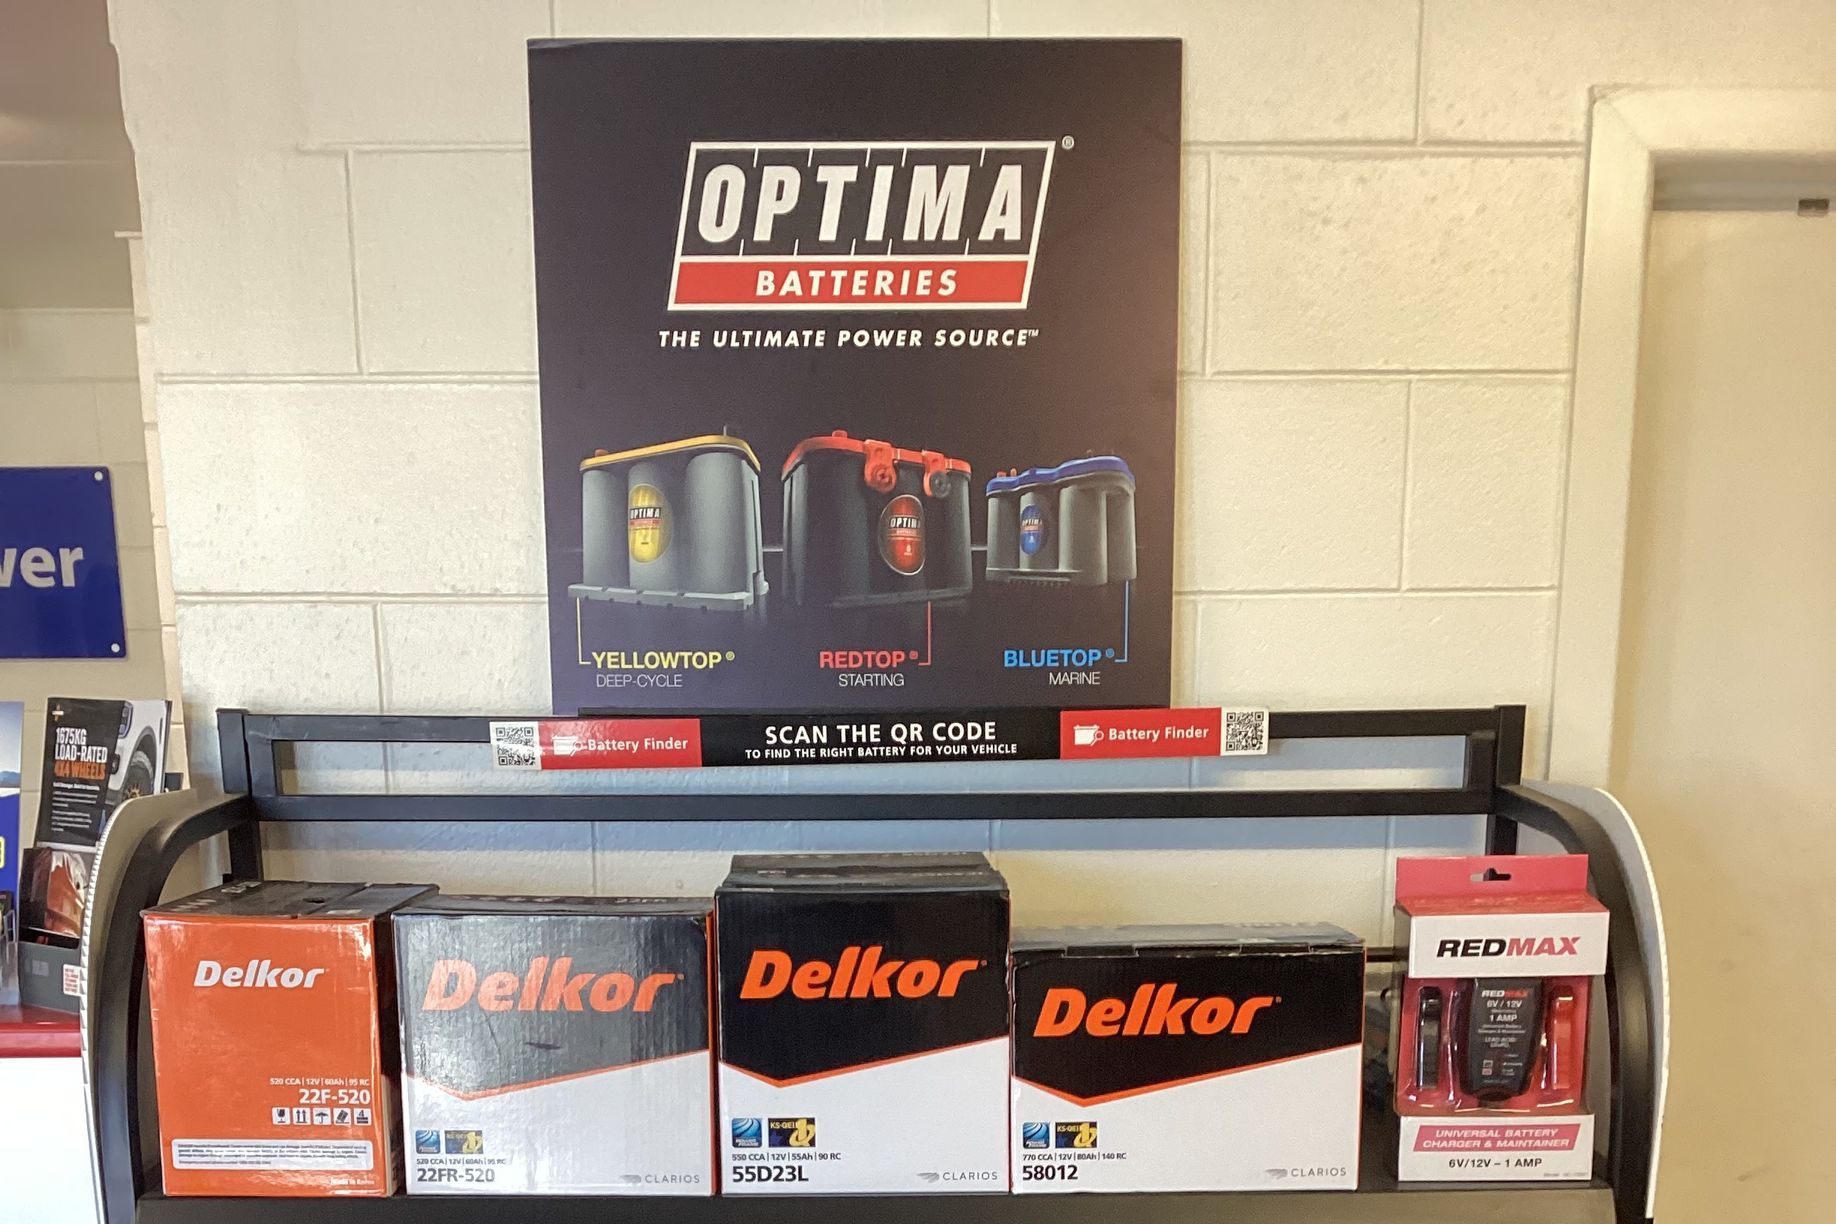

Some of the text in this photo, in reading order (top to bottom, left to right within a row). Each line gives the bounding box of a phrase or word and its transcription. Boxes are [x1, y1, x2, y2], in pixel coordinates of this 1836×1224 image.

[697, 163, 1023, 243] OPTIMA
[755, 269, 958, 297] BATTERIES
[659, 330, 701, 347] THE
[713, 330, 826, 347] ULTIMATE
[838, 330, 922, 347] POWER
[592, 651, 722, 669] YELLOWTOP
[820, 651, 905, 668] REDTOP
[1004, 649, 1102, 667] BLUETOP
[596, 674, 683, 687] DEEP-CYCLE
[838, 673, 904, 687] STARTING
[1048, 671, 1101, 685] MARINE
[56, 727, 87, 745] 1675KG
[765, 722, 996, 745] SCAN THE QR CODE
[1108, 726, 1209, 742] Battery Finder
[55, 744, 108, 763] LOAD-RATED
[587, 738, 689, 753] Battery Finder
[745, 744, 1017, 759] TO FIND THE RIGHT BATTERY FOR YOUR VEHICLE
[1437, 937, 1581, 957] REDMAX
[193, 959, 325, 988] Delkor
[740, 945, 979, 1000] Delkor
[422, 955, 678, 1013] Delkor
[1033, 983, 1274, 1037] Delkor
[299, 1089, 371, 1105] 22F-520
[1436, 1128, 1559, 1138] UNIVERSAL BATTERY
[1423, 1140, 1480, 1148] CHARGER
[1496, 1139, 1570, 1148] MAINTAINER
[830, 1152, 841, 1160] RC
[1449, 1158, 1491, 1168] 6V/12V
[1515, 1158, 1542, 1167] AMP
[417, 1168, 495, 1182] 22FR-520
[644, 1174, 700, 1184] CLARIOS
[733, 1165, 809, 1182] 55D23L
[943, 1171, 998, 1180] CLARIOS
[1022, 1165, 1078, 1180] 58012
[1291, 1167, 1347, 1178] CLARIOS
